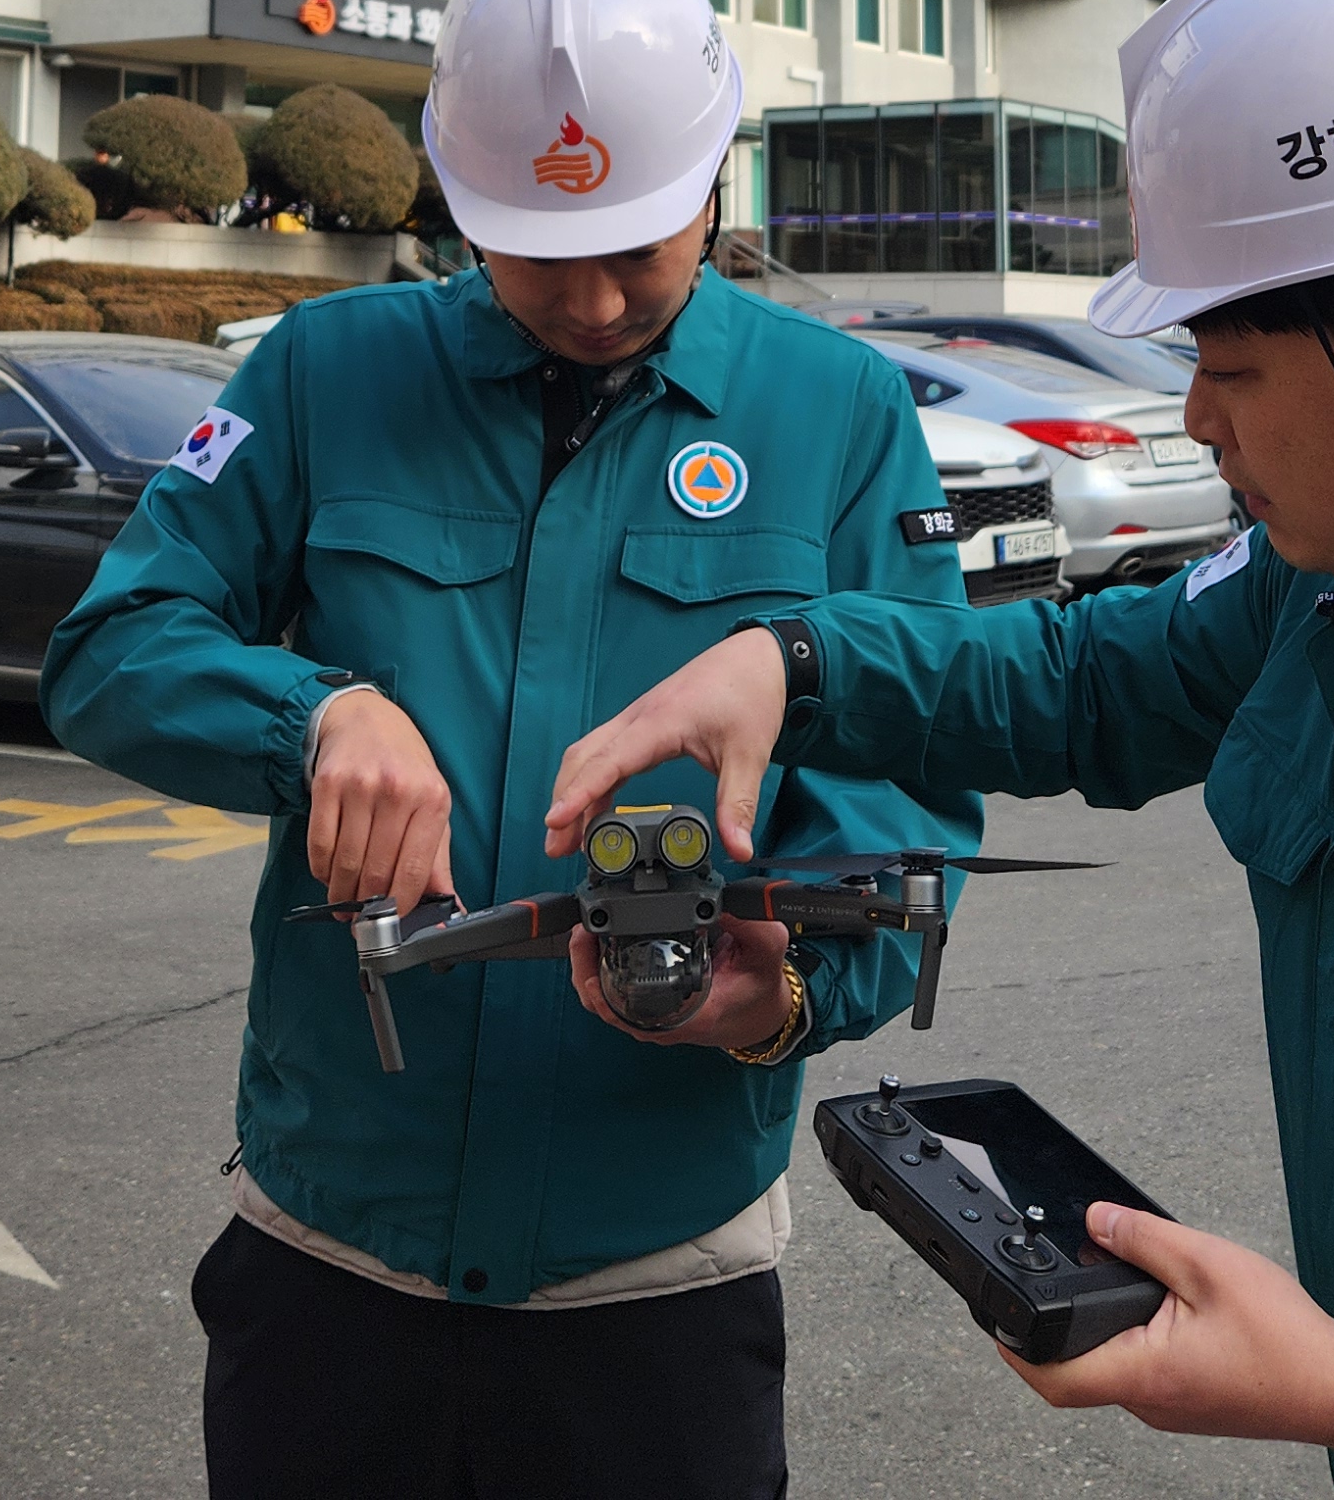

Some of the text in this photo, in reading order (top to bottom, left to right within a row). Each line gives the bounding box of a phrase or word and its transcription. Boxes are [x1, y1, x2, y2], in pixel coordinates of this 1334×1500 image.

[918, 511, 955, 534] 강화군
[780, 904, 806, 914] MAVIC
[808, 906, 815, 914] 2
